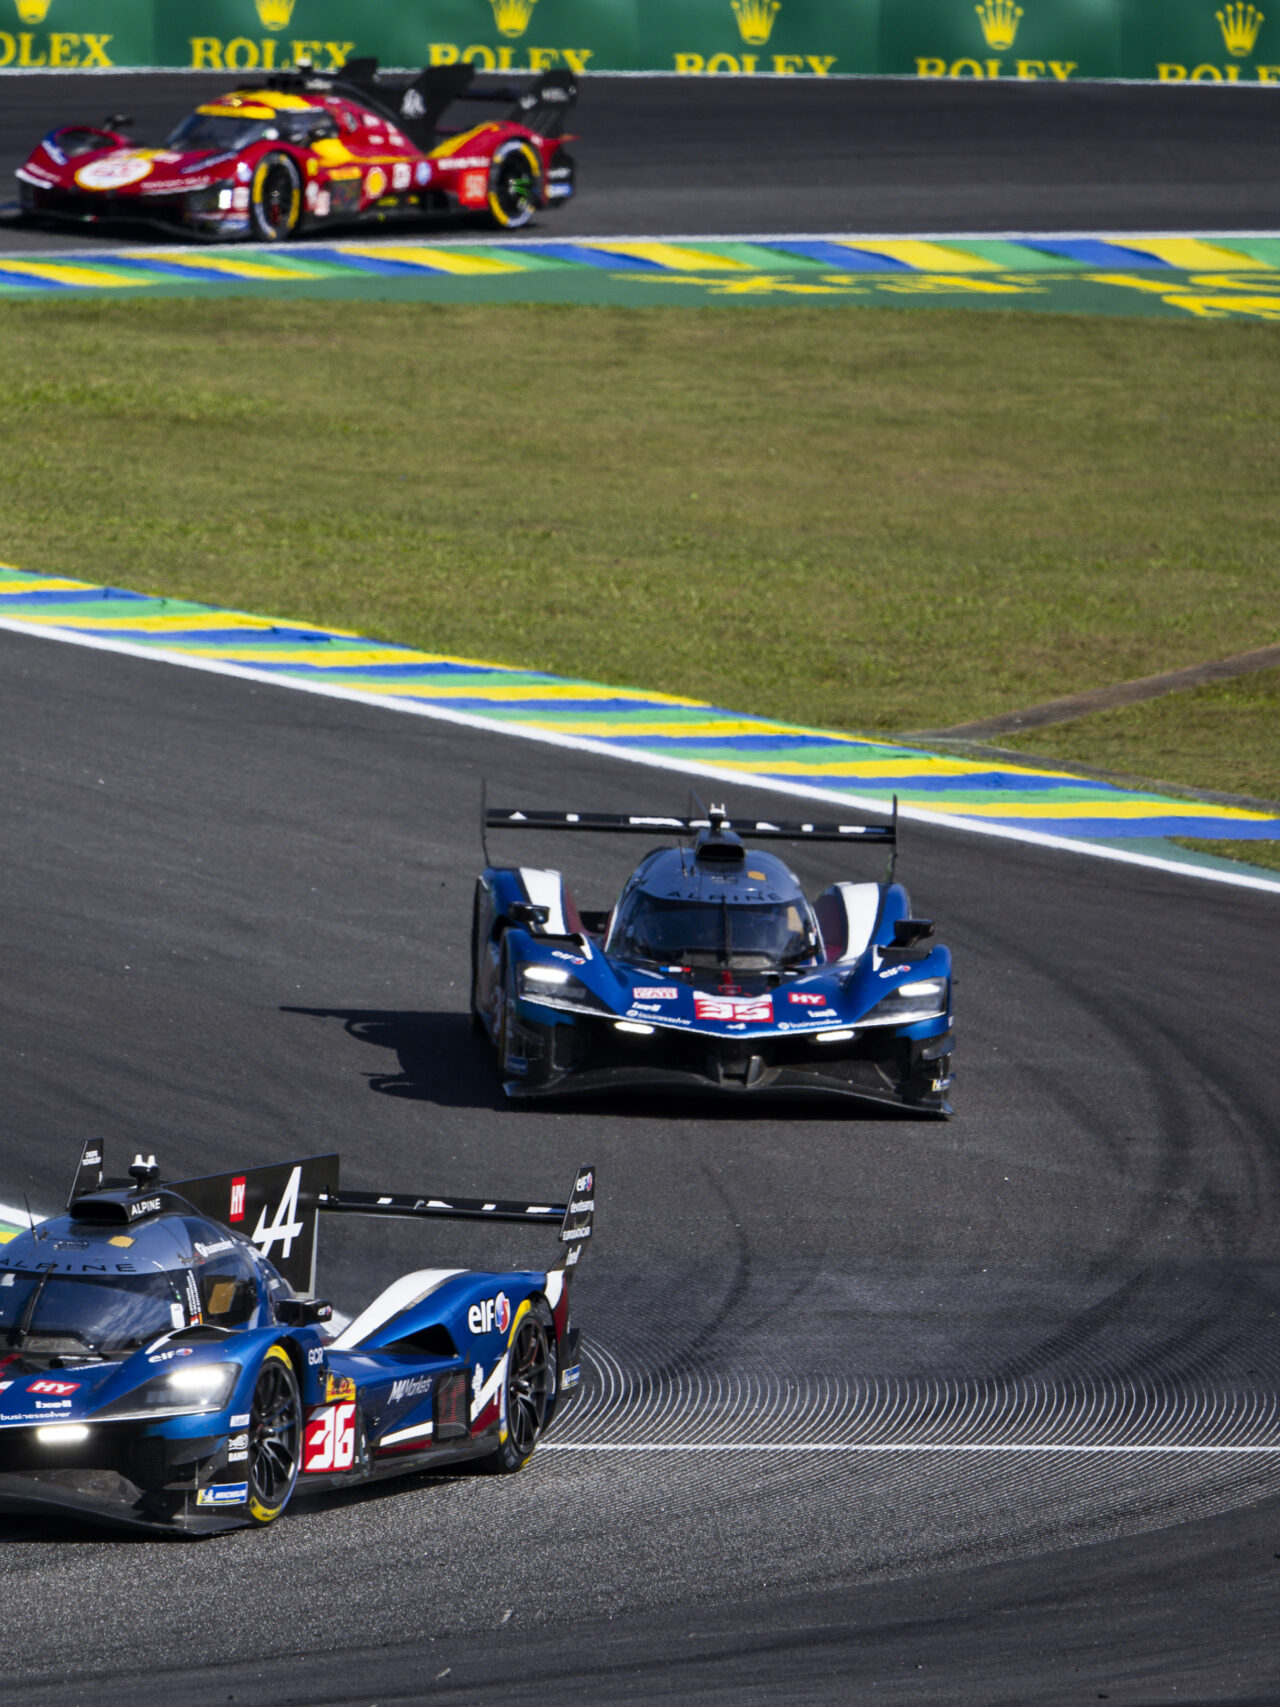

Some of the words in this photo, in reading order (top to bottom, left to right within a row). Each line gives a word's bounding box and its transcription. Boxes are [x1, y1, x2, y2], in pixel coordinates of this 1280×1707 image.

[791, 993, 823, 1004] HY
[697, 999, 771, 1021] 35
[131, 1197, 161, 1216] ALPINE
[230, 1184, 246, 1215] HY
[467, 1299, 496, 1334] elf
[148, 1350, 177, 1363] elf
[33, 1381, 76, 1394] HY
[0, 1410, 72, 1422] businessolver
[305, 1403, 357, 1469] 36
